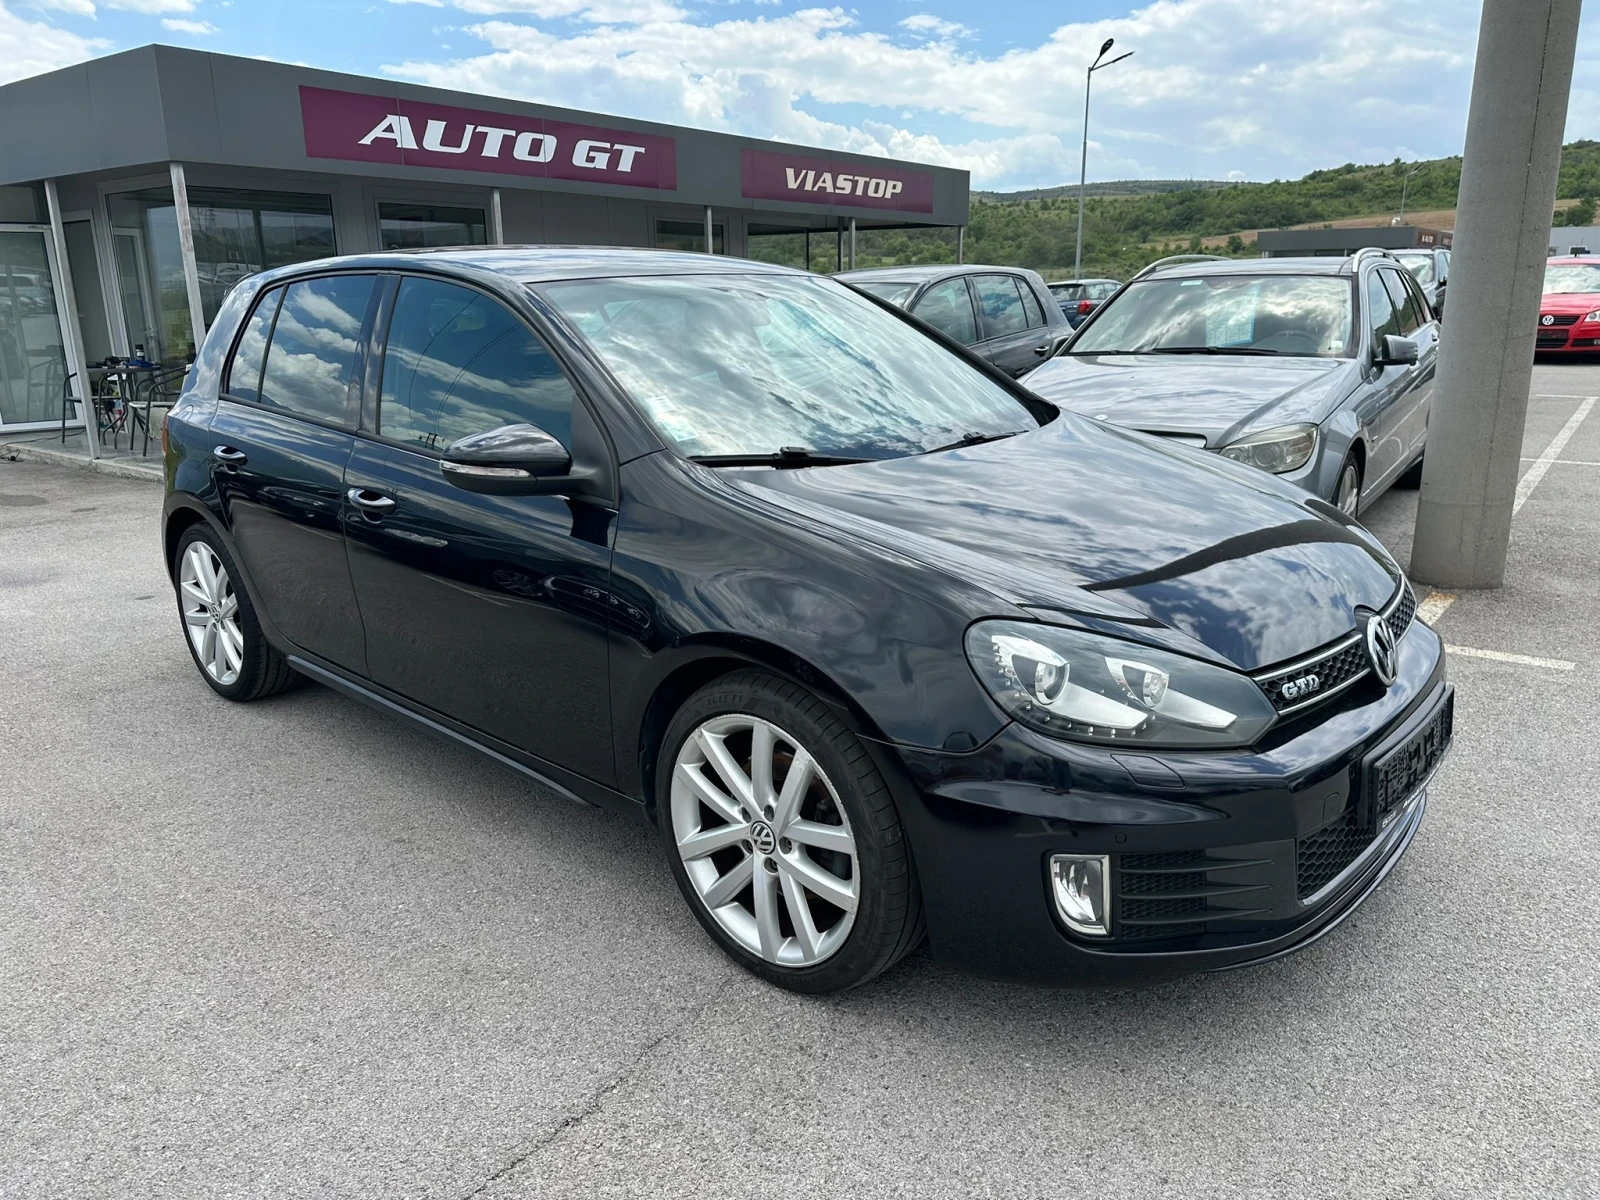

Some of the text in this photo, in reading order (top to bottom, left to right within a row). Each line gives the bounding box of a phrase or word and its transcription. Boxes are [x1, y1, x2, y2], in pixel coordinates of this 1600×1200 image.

[357, 114, 646, 173] AUTO GT
[785, 167, 903, 199] VIASTOP
[1282, 674, 1320, 700] GTD
